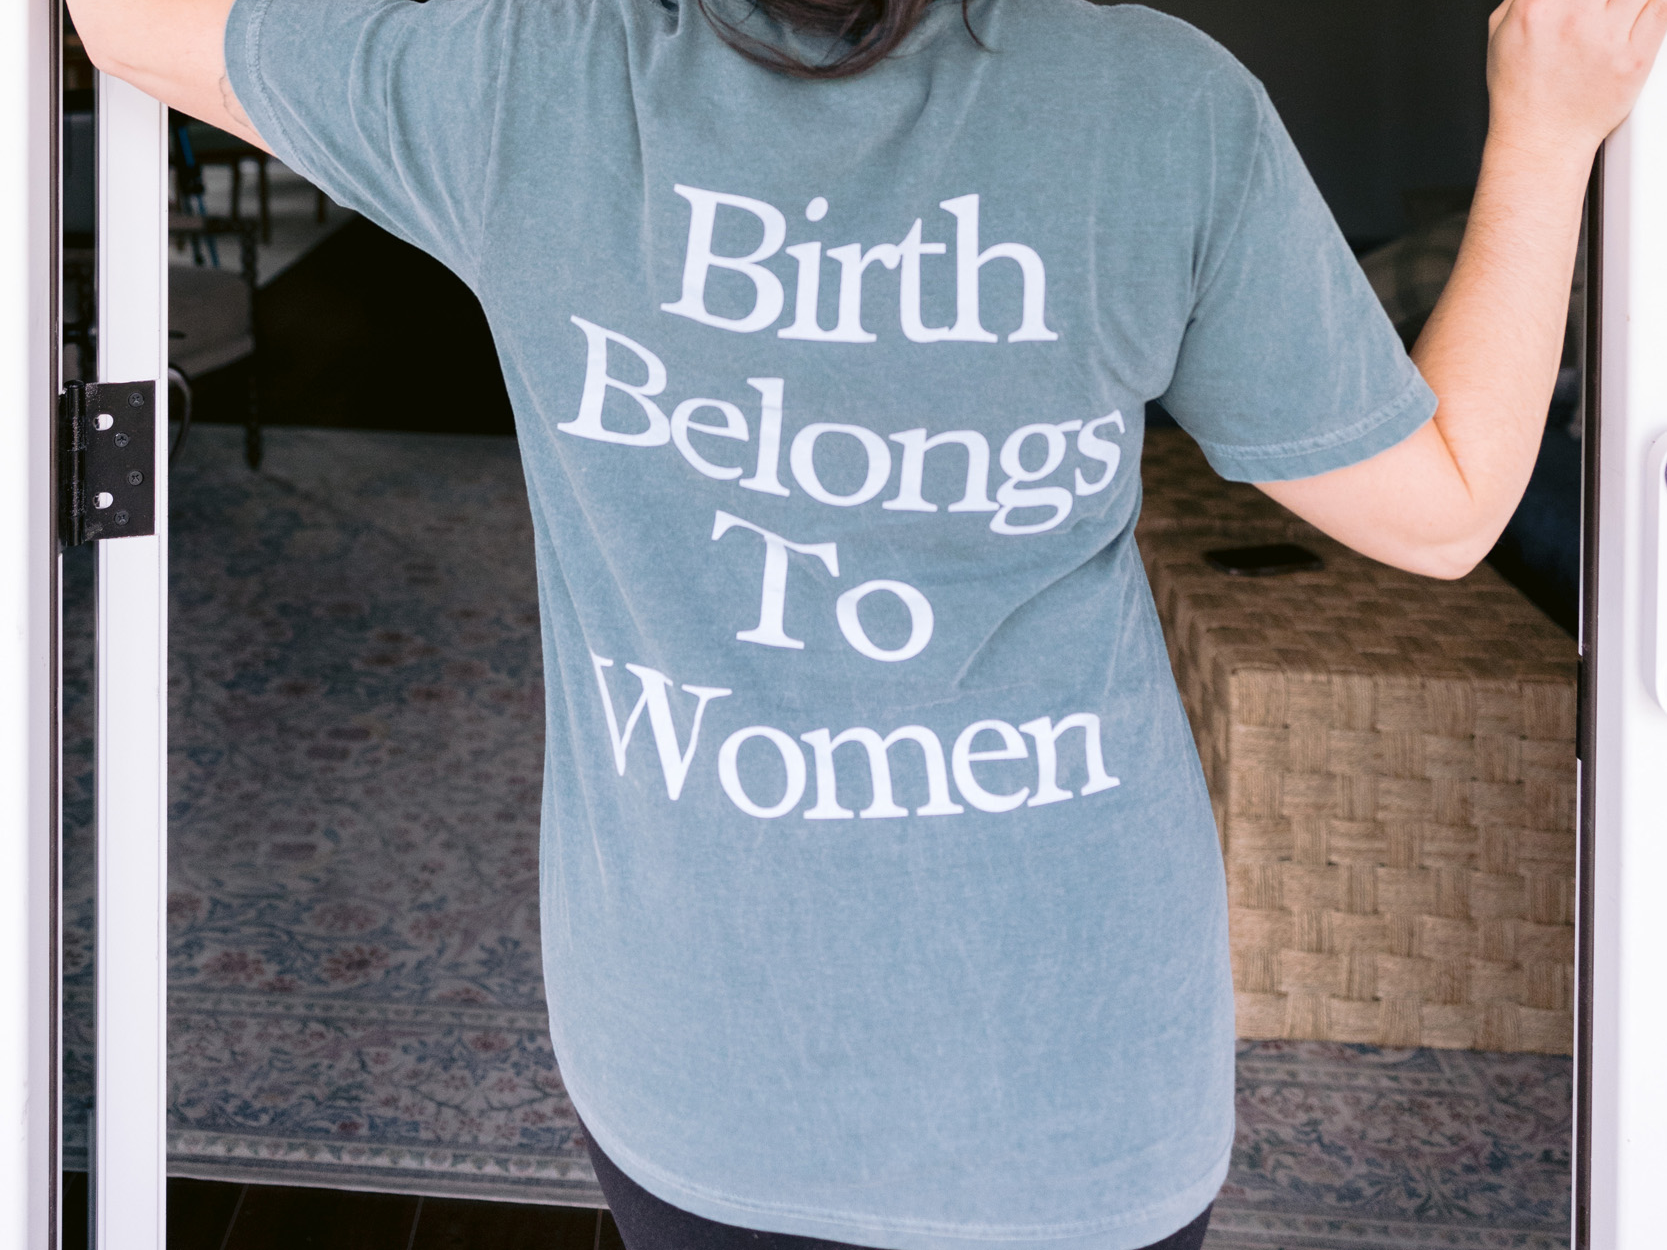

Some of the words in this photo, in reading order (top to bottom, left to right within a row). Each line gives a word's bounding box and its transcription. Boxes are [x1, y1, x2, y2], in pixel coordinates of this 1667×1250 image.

[660, 183, 1059, 344] Birth
[556, 314, 1126, 536] Belongs
[711, 509, 935, 663] To
[589, 648, 1121, 820] Women
